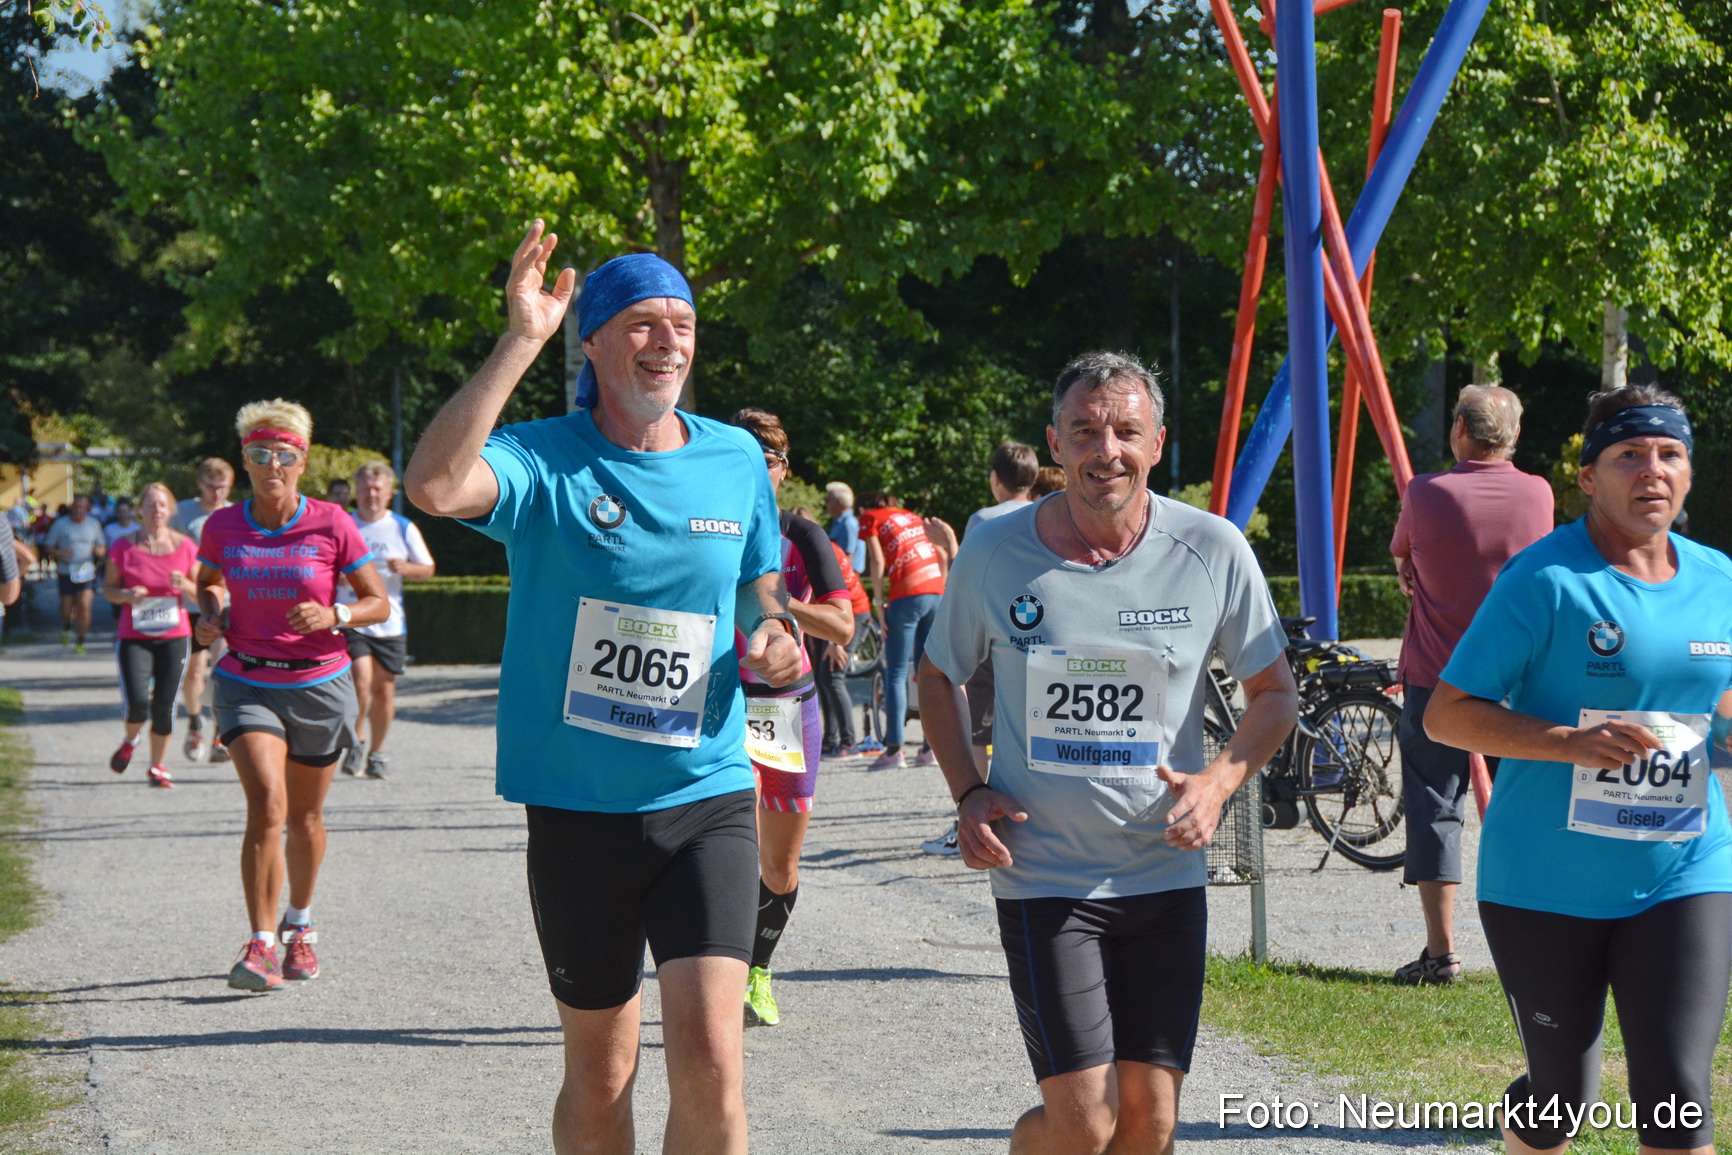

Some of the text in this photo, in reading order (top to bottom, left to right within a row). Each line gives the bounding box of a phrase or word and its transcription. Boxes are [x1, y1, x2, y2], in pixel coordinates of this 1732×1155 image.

[688, 518, 743, 536] BOCK
[588, 533, 625, 545] PARTL
[223, 545, 319, 558] BURNING FOR
[588, 543, 625, 551] Neumarkt
[229, 565, 315, 579] MARATHON
[247, 587, 298, 599] ATHEN
[1012, 595, 1041, 608] BMW
[1118, 607, 1191, 626] BOCK
[618, 617, 677, 638] BOCK
[1592, 622, 1622, 634] BMW
[1010, 635, 1046, 647] PARTL
[577, 664, 583, 672] D
[590, 639, 690, 690] 2065
[1067, 659, 1126, 672] BOCK
[1587, 661, 1626, 671] PARTL
[1587, 670, 1626, 678] Neumarkt
[597, 684, 667, 703] PARTL Neumarkt
[1046, 683, 1144, 722] 2582
[610, 705, 657, 728] Frank
[1054, 727, 1082, 736] PARTL
[1056, 744, 1131, 765] Wolfgang
[1582, 773, 1588, 781] D
[1603, 789, 1632, 800] PARTL
[1617, 809, 1666, 827] Gisela
